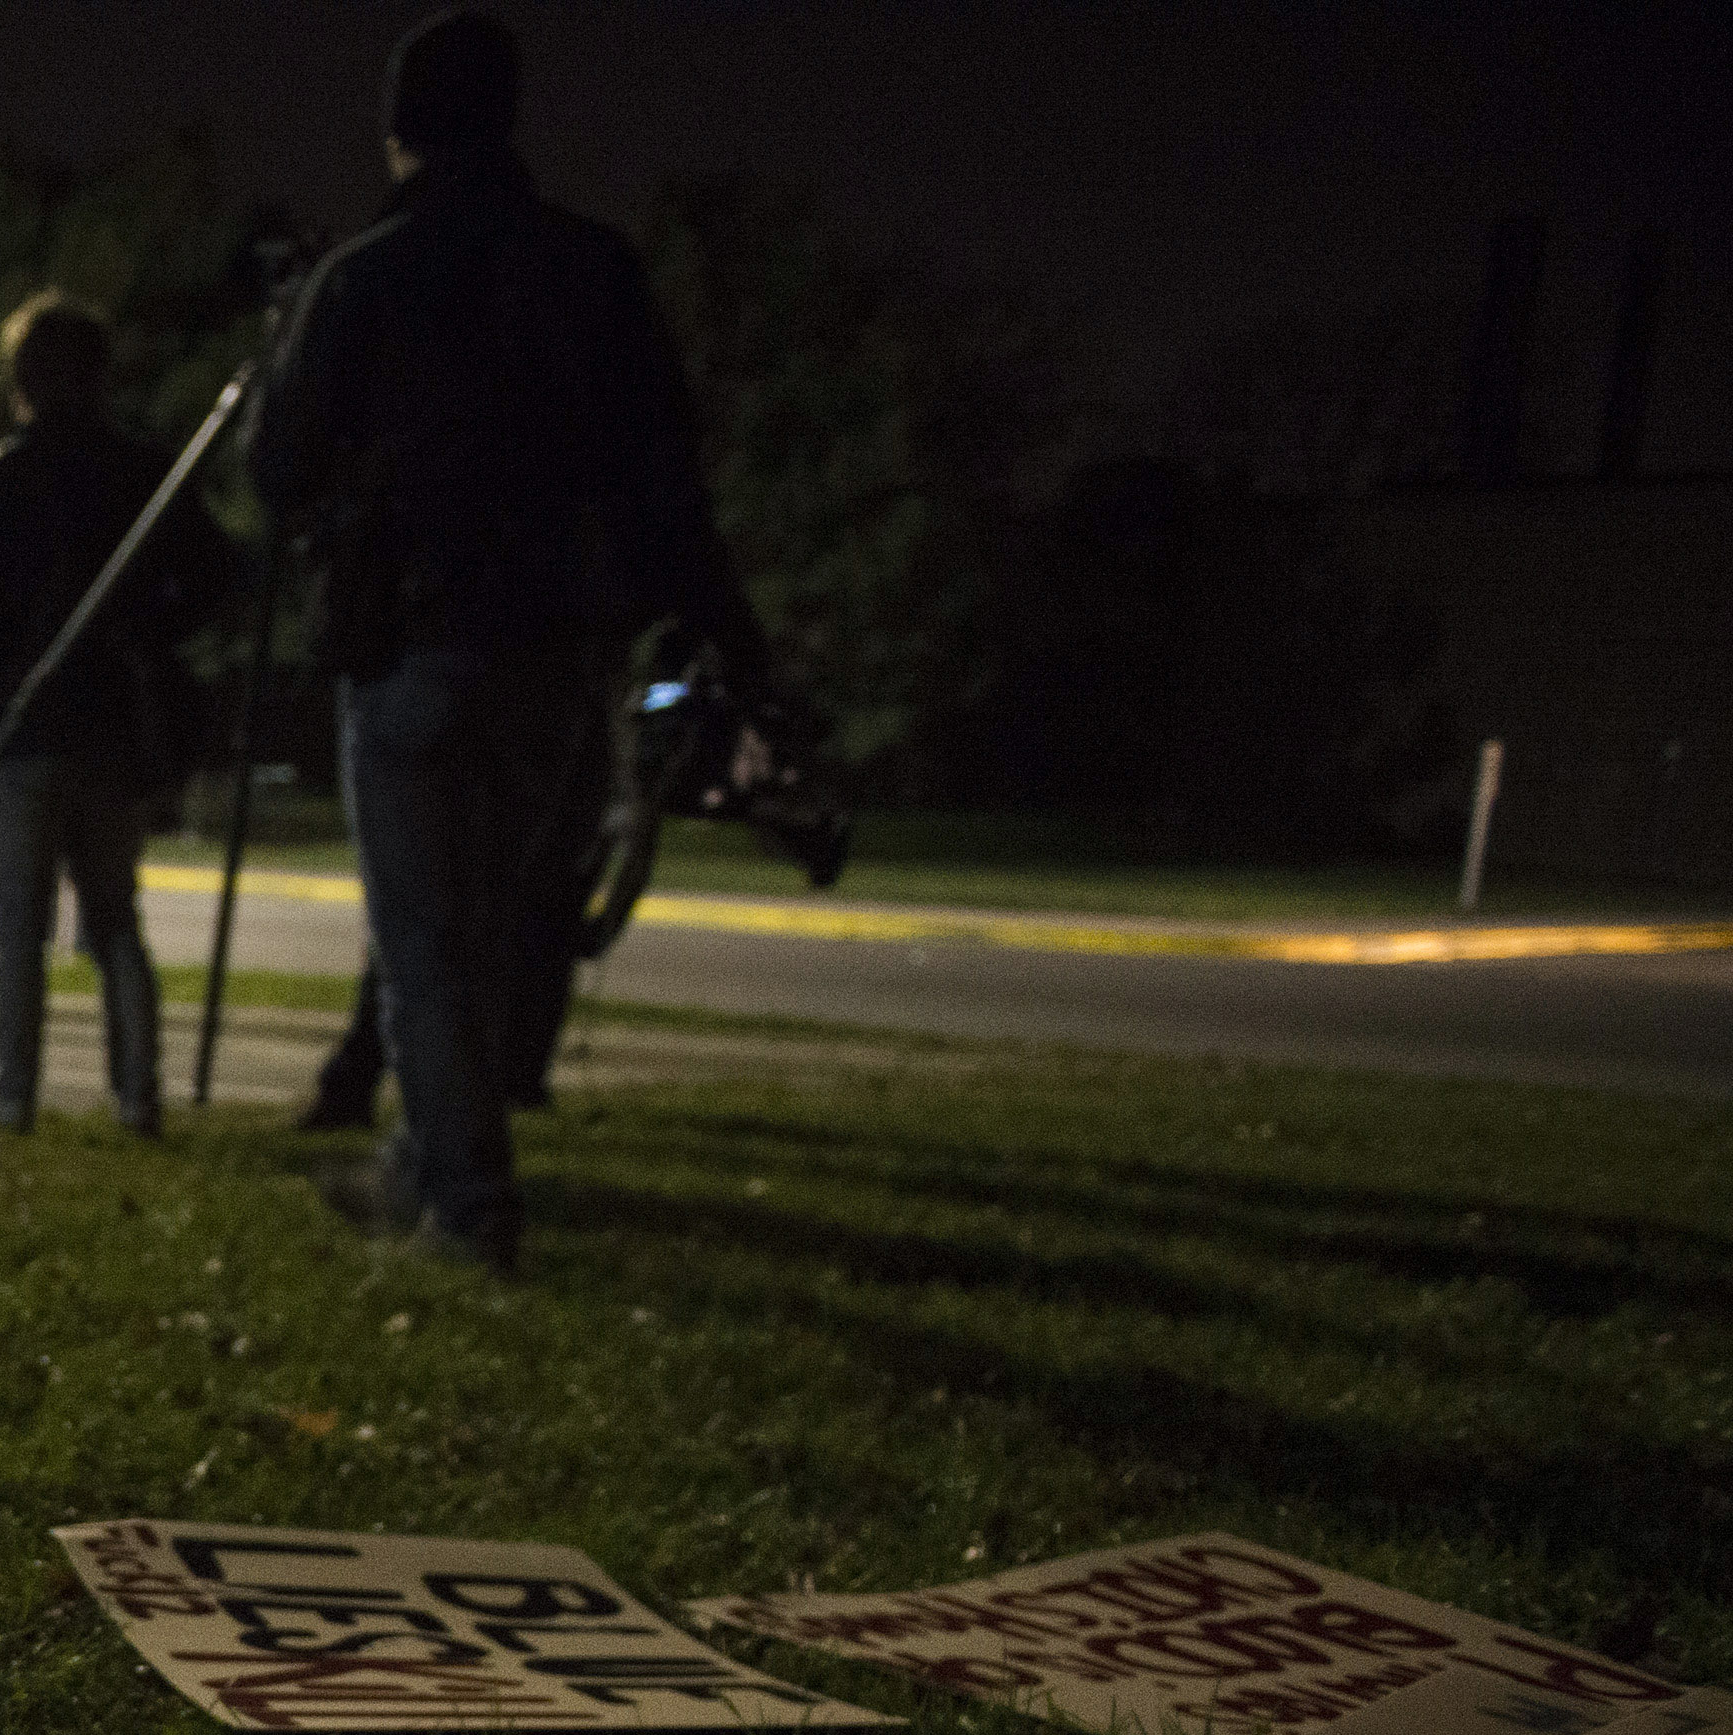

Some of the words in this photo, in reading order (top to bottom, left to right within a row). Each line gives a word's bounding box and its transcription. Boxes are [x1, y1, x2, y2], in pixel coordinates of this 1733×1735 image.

[171, 1536, 493, 1660] LIES
[419, 1572, 831, 1706] BLUE
[1085, 1600, 1457, 1678] BLOOD
